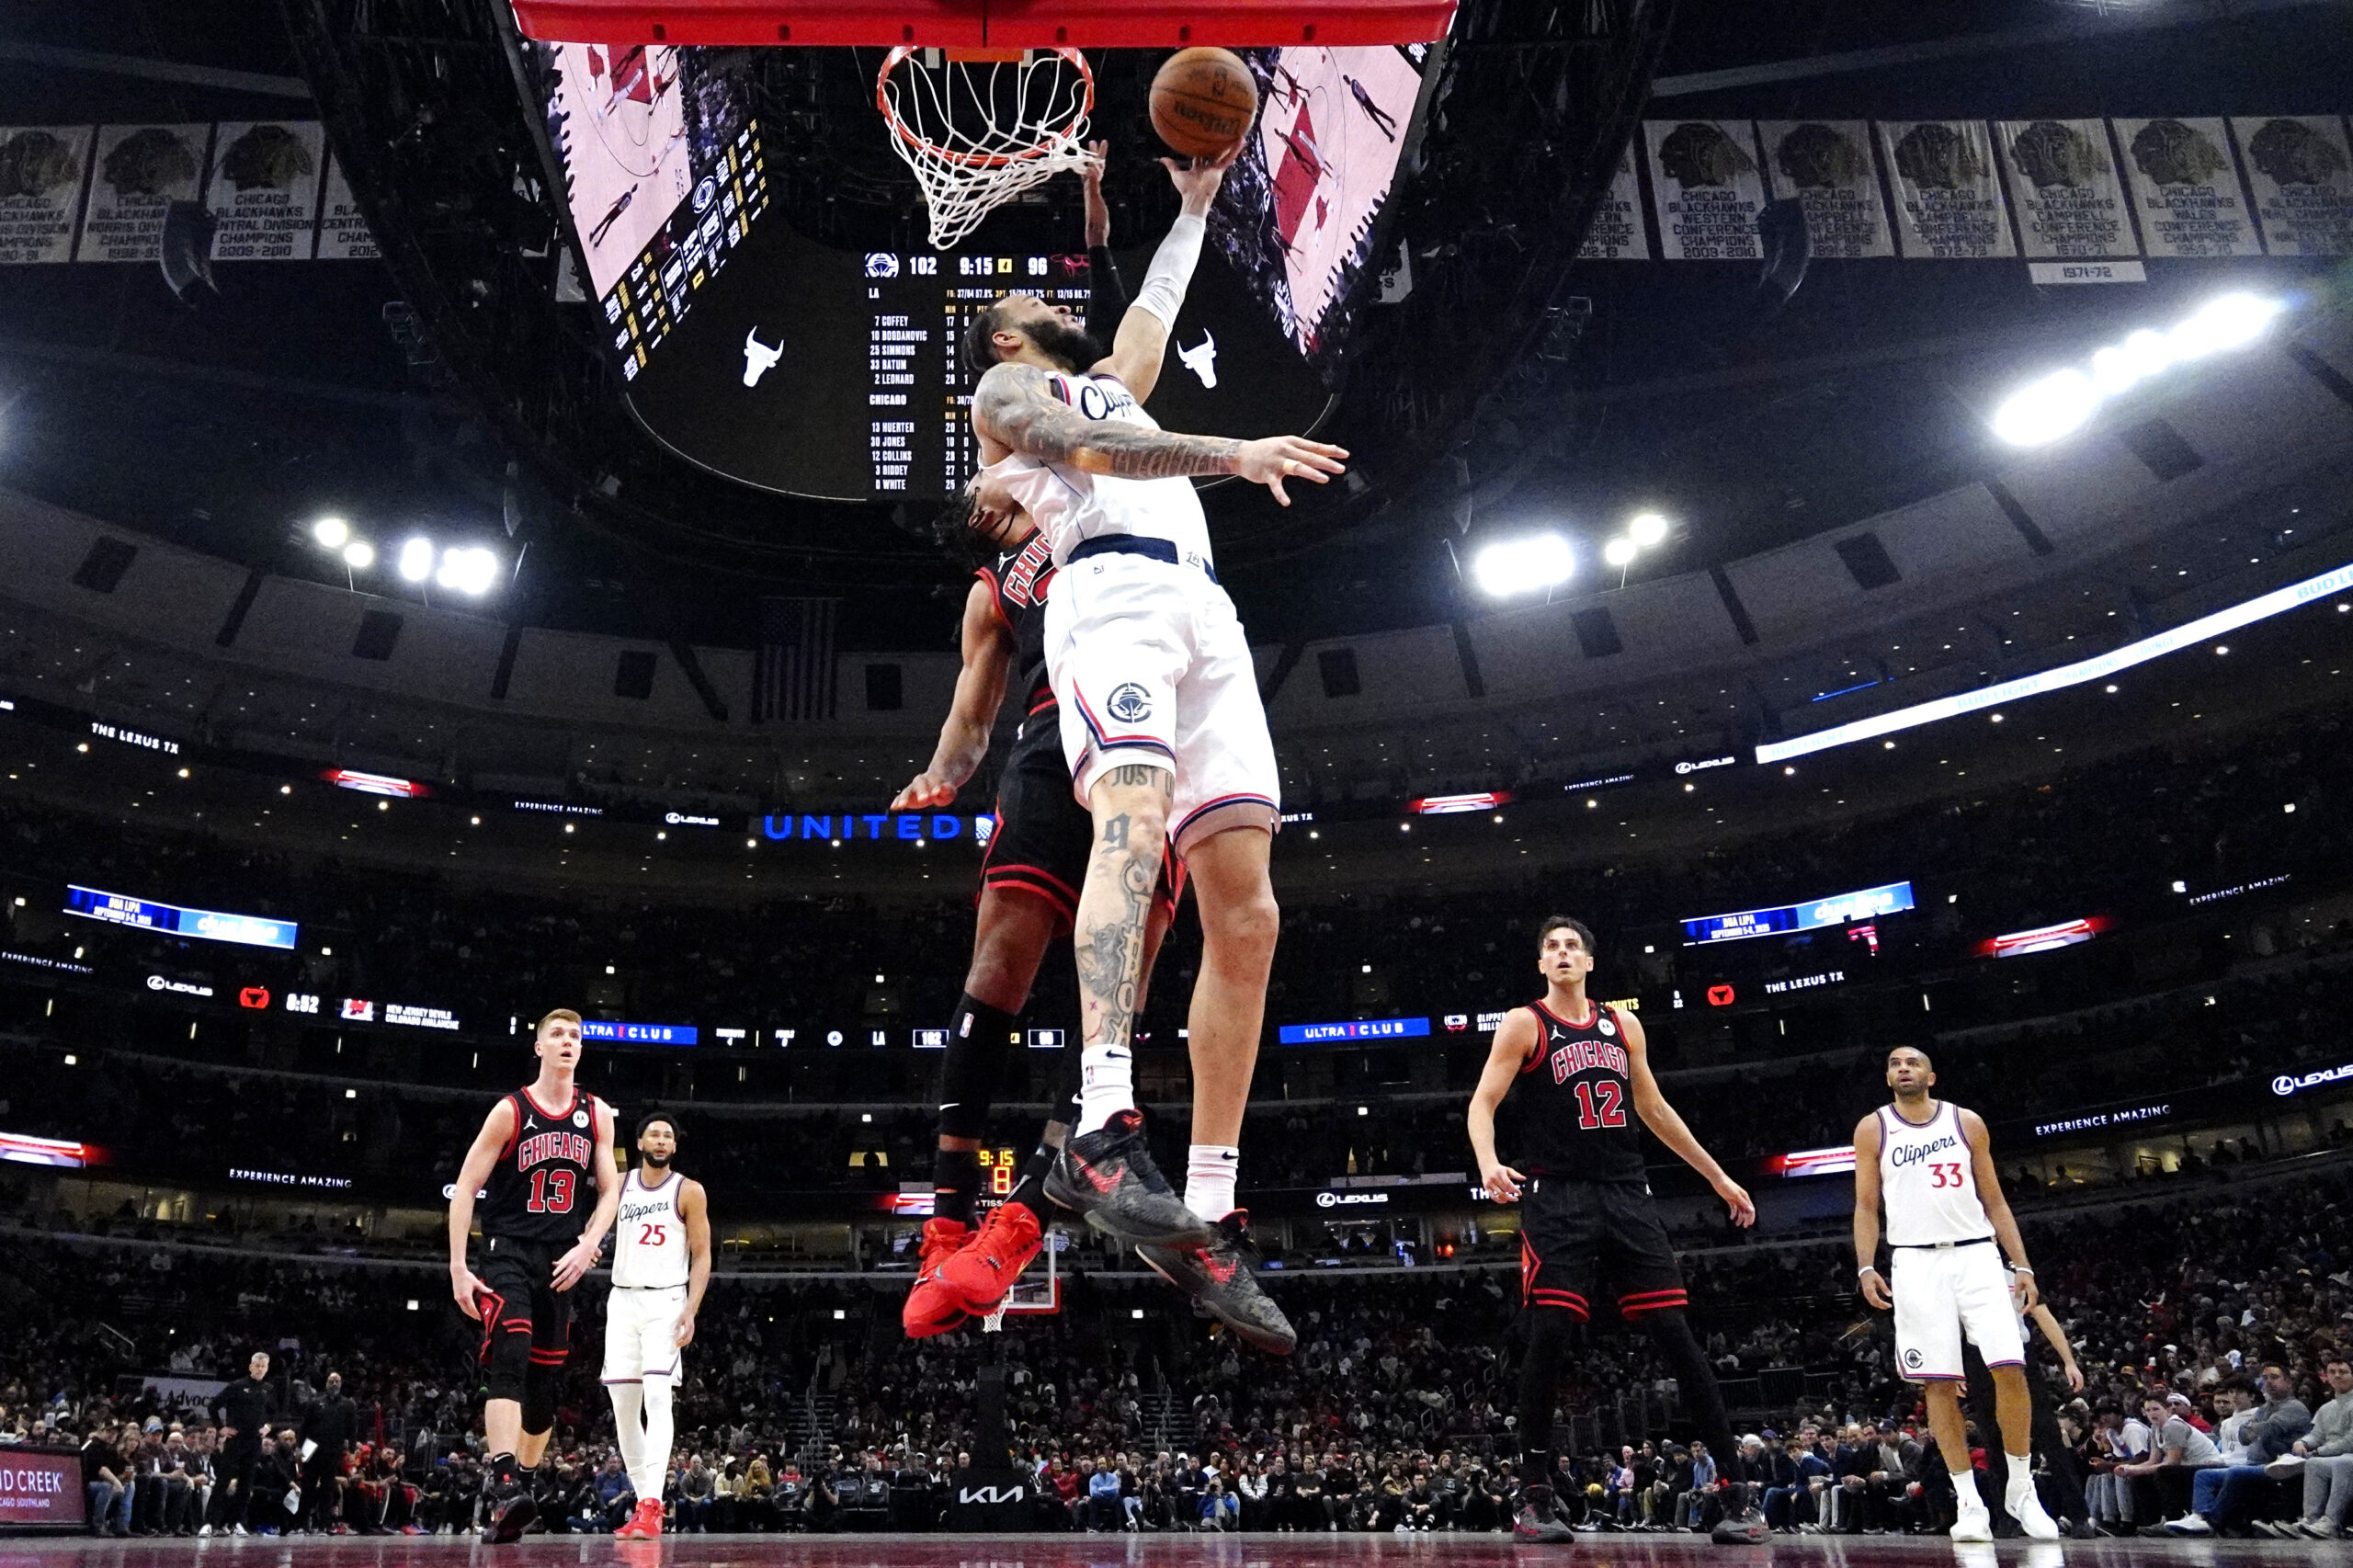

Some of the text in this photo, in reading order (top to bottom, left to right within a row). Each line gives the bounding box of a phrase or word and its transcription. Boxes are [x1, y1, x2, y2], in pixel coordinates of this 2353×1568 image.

[1681, 191, 1736, 201] CHICAGO
[1920, 189, 1975, 200] CHICAGO
[2040, 188, 2095, 199] CHICAGO
[2159, 187, 2216, 197] CHICAGO
[235, 194, 290, 205] CHICAGO
[2026, 199, 2114, 210] BLACKHAWKS
[216, 206, 303, 218] BLACKHAWKS
[1668, 202, 1756, 213] BLACKHAWKS
[1683, 213, 1746, 223] WESTERN
[263, 221, 313, 231] DIVISION
[1673, 224, 1759, 235] CONFERENCE
[220, 233, 293, 244] CHAMPIONS
[1681, 236, 1755, 247] CHAMPIONS
[2042, 233, 2116, 244] CHAMPIONS
[683, 229, 704, 272] 9:15
[910, 257, 937, 275] 102
[960, 257, 993, 275] 9:15
[1029, 257, 1047, 275] 96
[868, 287, 880, 299] LA
[874, 315, 881, 327] 7
[881, 315, 909, 327] COFFEY
[946, 315, 955, 327] 17
[870, 330, 881, 342] 10
[946, 330, 955, 342] 15
[870, 344, 955, 356] 25 SIMMONS 14
[870, 358, 955, 370] 33 BATUM 14
[874, 373, 969, 385] 2 LEONARD 1
[869, 393, 907, 405] CHICAGO
[871, 421, 969, 434] 13 HUERTER 20 1
[881, 436, 906, 448] JONES
[946, 436, 955, 448] 10
[963, 436, 970, 448] 0
[871, 449, 881, 461] 12
[881, 449, 913, 461] COLLINS
[963, 450, 969, 462] 3
[875, 464, 969, 476] 3 GIDDEY 27 1
[875, 479, 956, 491] 0 WHITE 25
[2297, 577, 2336, 600] BUD
[1957, 679, 2040, 710] BUD LIGHT
[91, 722, 179, 755] THE LEXUS TX
[1689, 756, 1735, 771] LEXUS
[1110, 765, 1158, 788] JUST
[515, 801, 603, 814] EXPERIENCE AMAZING
[764, 814, 962, 840] UNITED
[2190, 874, 2290, 904] EXPERIENCE AMAZING
[1, 951, 93, 973] EXPERIENCE AMAZING
[165, 981, 212, 996] LEXUS
[1765, 971, 1845, 994] THE LEXUS TX
[628, 1027, 672, 1040] CLUB
[1305, 1023, 1404, 1038] ULTRA CLUB
[872, 1030, 886, 1046] LA
[1551, 1040, 1629, 1085] CHICAGO
[2294, 1065, 2353, 1088] LEXUS
[1574, 1080, 1627, 1130] 12
[2036, 1105, 2168, 1135] EXPERIENCE AMAZING
[518, 1131, 592, 1172] CHICAGO
[1892, 1134, 1958, 1168] Clippers
[979, 1151, 1014, 1165] 9:15
[229, 1168, 352, 1187] EXPERIENCE AMAZING
[994, 1166, 1010, 1194] 8
[1928, 1162, 1964, 1189] 33
[527, 1168, 577, 1214] 13
[1337, 1193, 1389, 1204] LEXUS
[620, 1199, 671, 1223] Clippers
[638, 1223, 666, 1247] 25
[17, 1471, 63, 1493] CREEK
[16, 1498, 51, 1508] SOUTHLAND
